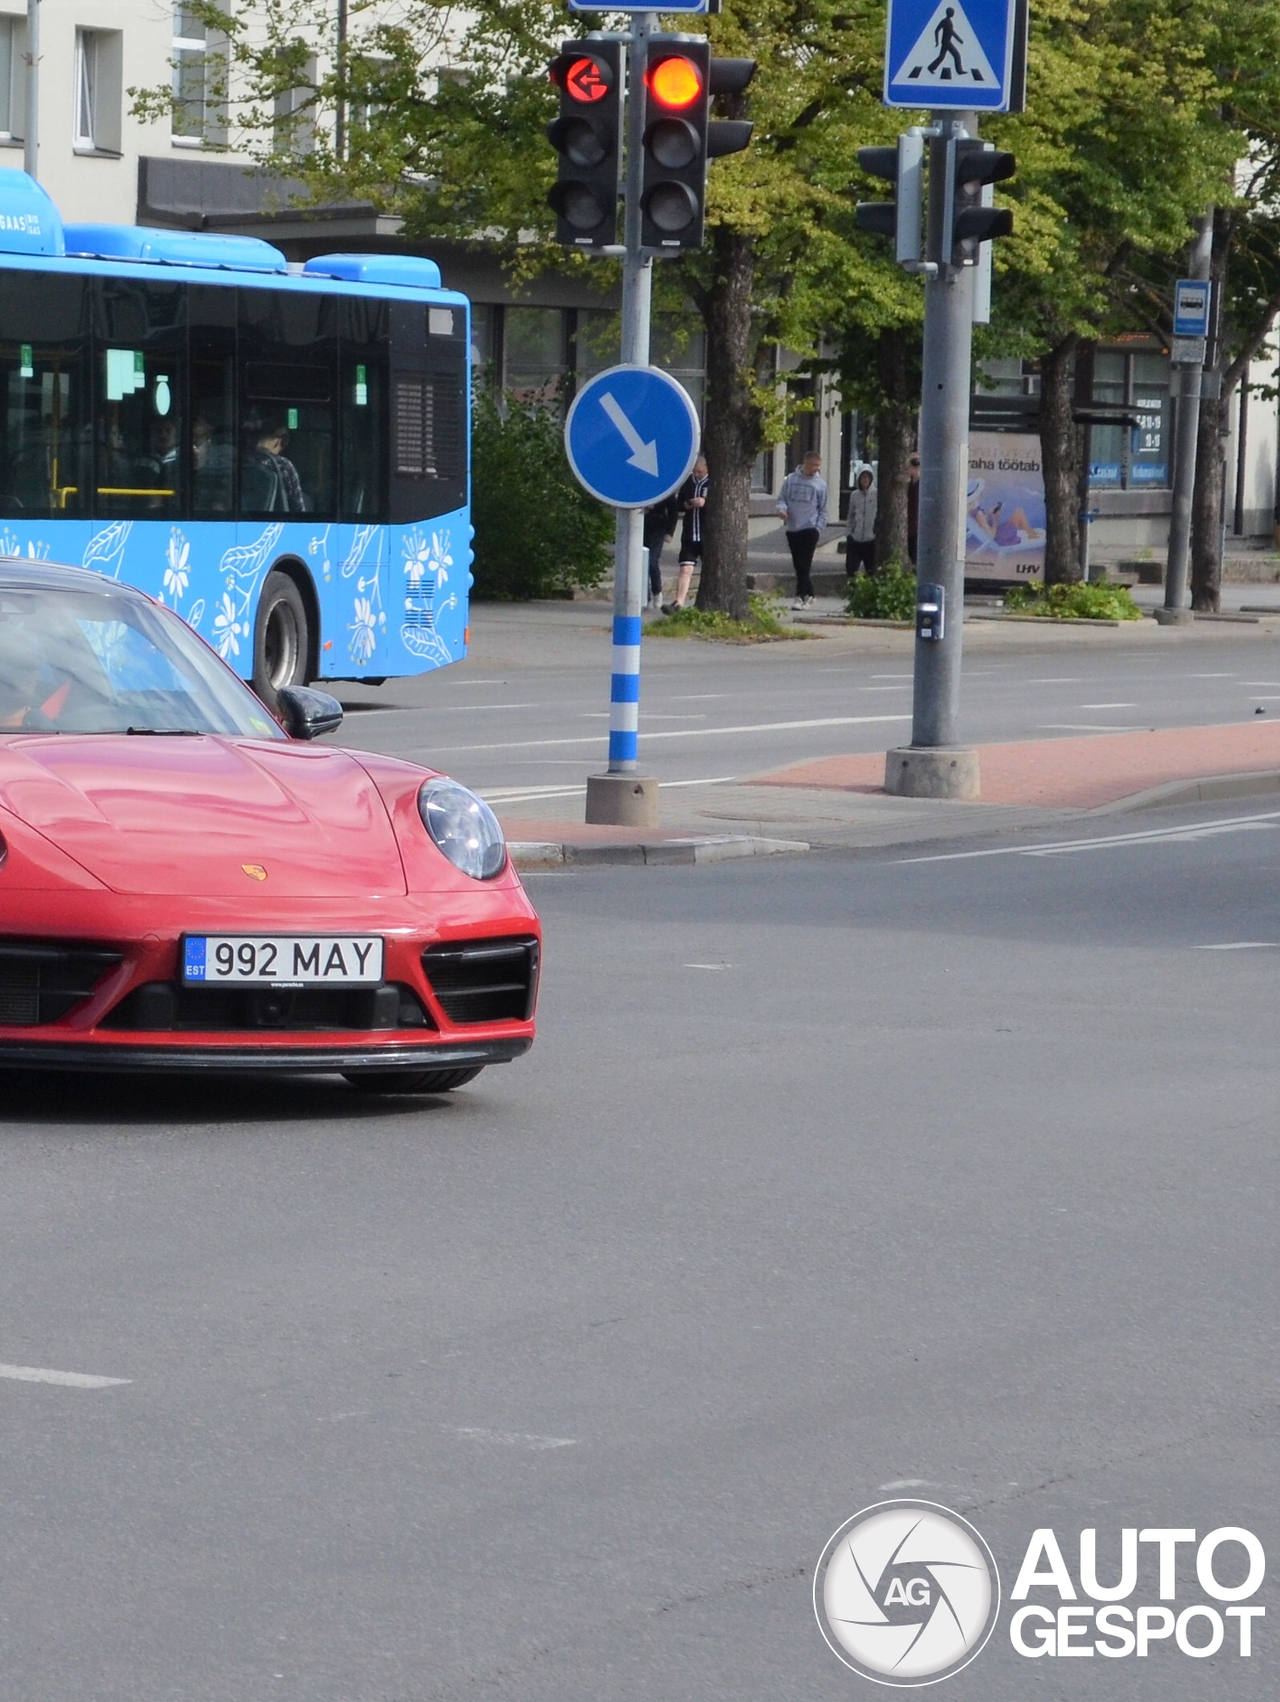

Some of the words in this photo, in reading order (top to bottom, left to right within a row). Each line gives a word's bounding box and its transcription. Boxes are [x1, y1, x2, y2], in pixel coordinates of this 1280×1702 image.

[998, 458, 1040, 471] töötab
[1016, 564, 1041, 574] LHV
[215, 943, 278, 976] 992
[293, 943, 373, 976] MAY
[186, 965, 205, 976] EST
